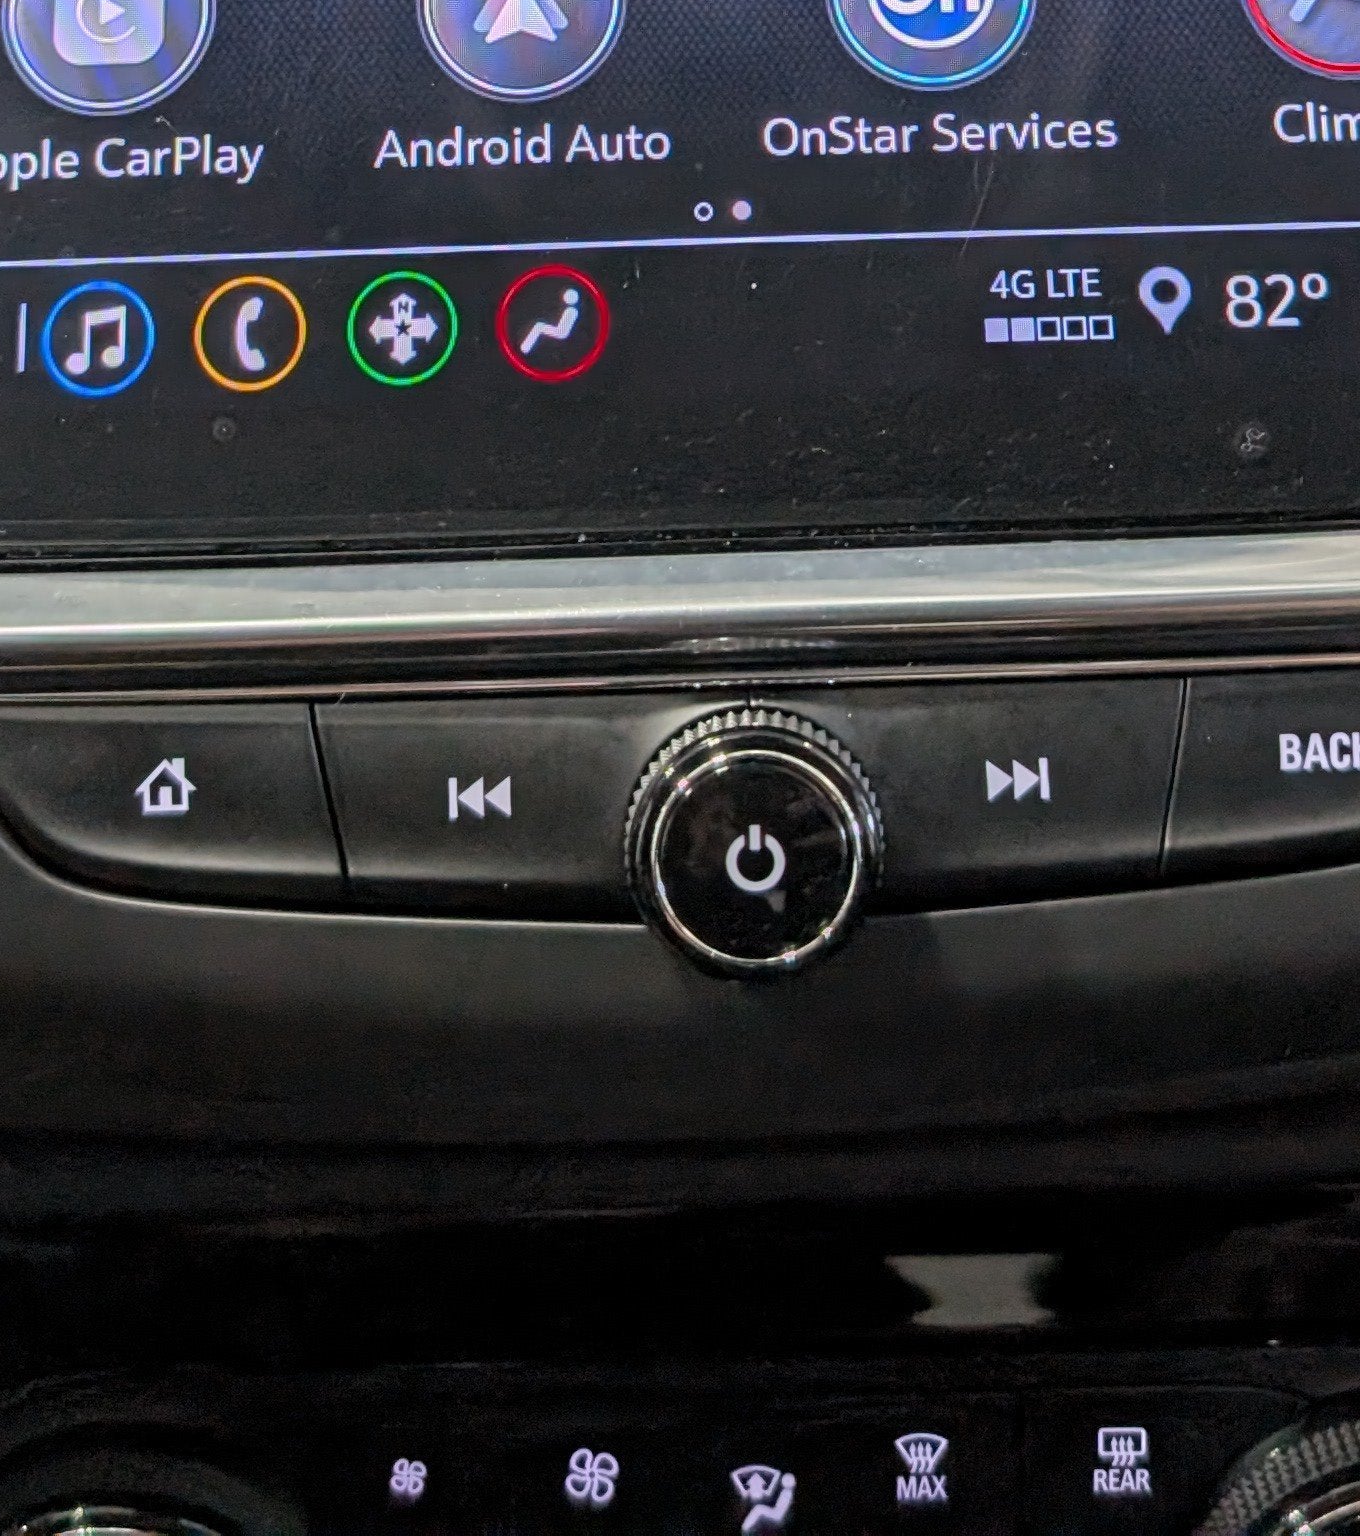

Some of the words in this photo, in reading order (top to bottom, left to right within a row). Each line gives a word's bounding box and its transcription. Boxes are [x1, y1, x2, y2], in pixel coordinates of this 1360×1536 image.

[373, 122, 551, 170] Android
[565, 123, 672, 164] Auto
[762, 114, 919, 157] OnStar
[932, 111, 1119, 153] Services
[94, 132, 265, 185] CarPlay
[989, 269, 1035, 300] 4G
[1046, 267, 1103, 298] LTE
[896, 1474, 948, 1502] MAX
[1093, 1467, 1151, 1493] REAR
